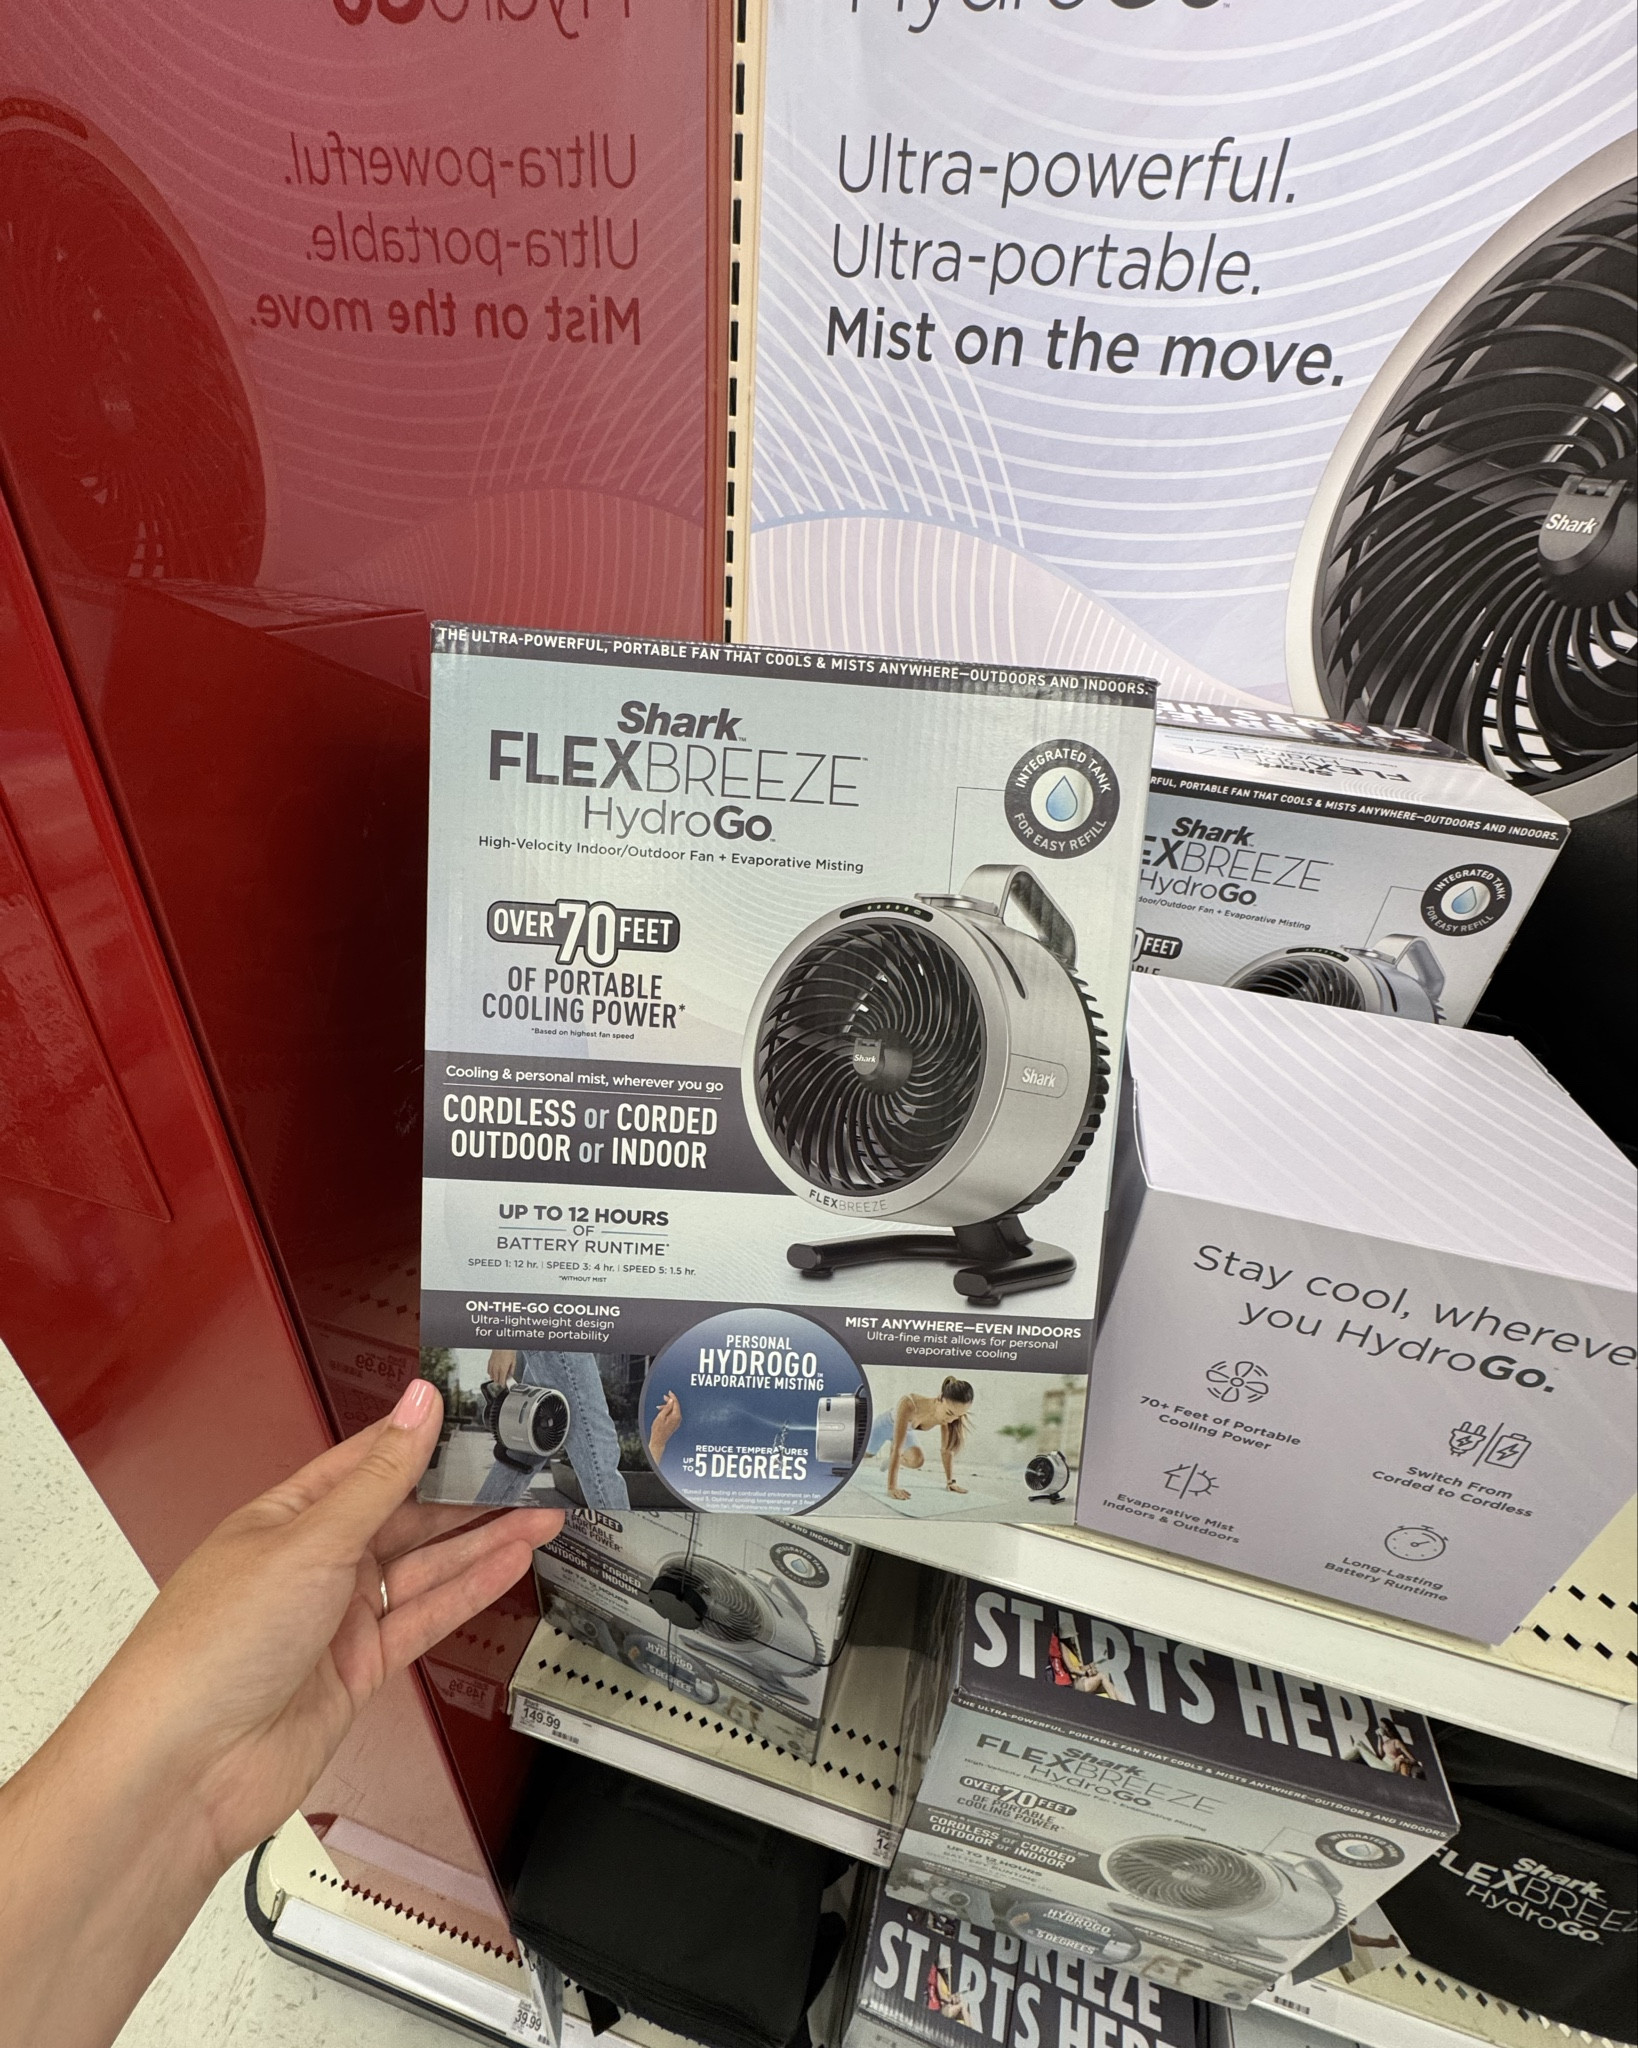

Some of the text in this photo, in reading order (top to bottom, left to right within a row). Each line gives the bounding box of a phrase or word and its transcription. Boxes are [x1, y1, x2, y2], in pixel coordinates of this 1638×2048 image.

[838, 132, 1297, 208] Ultra-powerful.
[832, 222, 1261, 296] Ultra-portable.
[826, 305, 1345, 387] Mist on the move.
[1545, 513, 1597, 534] Shark
[439, 627, 467, 641] THE
[471, 629, 608, 654] ULTRA-POWERFUL,
[613, 641, 687, 658] PORTABLE
[692, 647, 719, 660] FAN
[725, 650, 761, 664] THAT
[765, 653, 812, 668] COOLS
[817, 657, 826, 669] &
[831, 660, 875, 673] MISTS
[1050, 676, 1079, 689] AND
[1084, 678, 1149, 695] INDOORS.
[617, 700, 743, 741] Shark
[490, 729, 862, 807] FLEXBREEZE
[1015, 748, 1112, 794] INTEGRATED TANK
[584, 795, 773, 842] HydroGo
[1180, 780, 1228, 795] PORTABLE
[1231, 788, 1250, 797] FAN
[1253, 791, 1279, 801] THAT
[1281, 794, 1312, 807] COOLS
[1325, 800, 1356, 814] MISTS
[1483, 822, 1507, 833] AND
[1509, 826, 1559, 841] INDOORS.
[1014, 812, 1107, 852] FOR EASY REFILL
[1172, 817, 1254, 846] Shark
[479, 836, 864, 874] High-Velocity Indoor/Outdoor Fan + Evaporative Misting
[1141, 869, 1257, 905] HydroGo
[493, 902, 674, 965] OVER 70 FEET
[507, 965, 663, 1000] OF PORTABLE
[482, 992, 585, 1024] COOLING
[854, 1053, 877, 1065] Shark
[445, 1065, 724, 1093] Cooling & personal mist, wherever you go
[1021, 1067, 1057, 1089] Shark
[443, 1093, 718, 1136] CORDLESS or CORDED
[451, 1129, 707, 1169] OUTDOOR or INDOOR
[499, 1203, 669, 1227] UP TO 12 HOURS
[808, 1189, 888, 1212] FLEXBREEZE
[497, 1236, 579, 1252] BATTERY
[572, 1225, 595, 1236] OF
[467, 1258, 696, 1276] SPEED 1: 12 hr. SPEED 3: 4 hr. SPEED 5: 1.5 hr.
[465, 1300, 621, 1317] ON-THE-GO COOLING
[471, 1314, 615, 1330] Ultra-lightweight design
[1193, 1245, 1637, 1368] Stay cool, whereve
[475, 1326, 610, 1343] for ultimate portability
[726, 1335, 792, 1350] PERSONAL
[845, 1316, 878, 1328] MIST
[1016, 1325, 1082, 1339] INDOORS
[867, 1331, 1059, 1350] Ultra-fine mist allows for personal
[699, 1348, 817, 1378] HYDROGO
[905, 1345, 1018, 1361] evaporative cooling
[1238, 1302, 1555, 1393] you HydroGo.
[690, 1373, 824, 1391] EVAPORATIVE MISTING
[1140, 1395, 1301, 1445] 70+ Feet of Portable
[1158, 1414, 1272, 1450] Cooling Power
[695, 1444, 809, 1456] REDUCE TEMPERATURES
[695, 1453, 808, 1481] 5 DEGREES
[1372, 1470, 1533, 1517] Corded to Cordless
[1406, 1466, 1513, 1499] Switch From
[1102, 1499, 1155, 1520] Indoors
[1173, 1520, 1240, 1544] Outdoors
[1117, 1493, 1234, 1532] Evaporative Mist
[1324, 1562, 1448, 1601] Battery Runtime
[1342, 1557, 1444, 1590] Long-Lasting
[523, 1708, 561, 1729] 149.99
[976, 1734, 1227, 1814] FLEXBREEZE
[1063, 1748, 1143, 1776] Shark
[1031, 1765, 1152, 1806] HydroGo
[1513, 1858, 1605, 1899] Shark
[1466, 1884, 1600, 1941] HydroGo
[515, 2010, 541, 2031] 39.99
